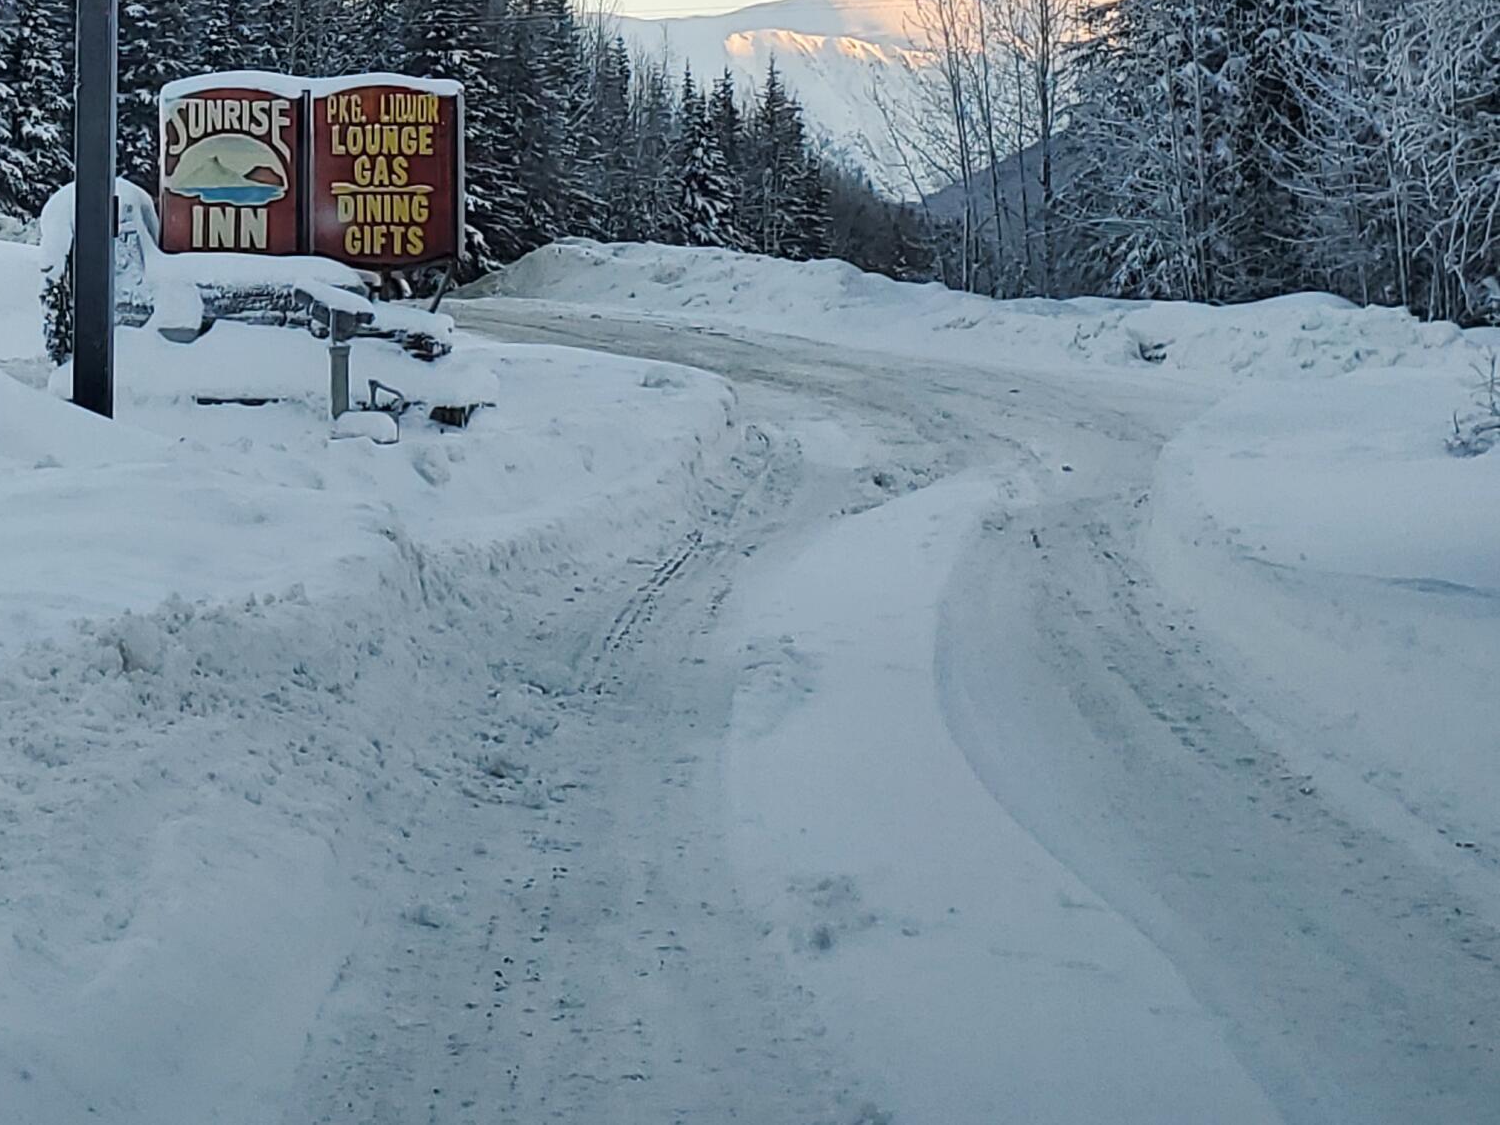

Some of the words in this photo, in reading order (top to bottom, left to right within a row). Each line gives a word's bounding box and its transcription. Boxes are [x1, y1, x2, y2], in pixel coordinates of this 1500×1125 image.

[327, 94, 367, 124] PKG.
[380, 93, 440, 124] LIQUOR
[167, 98, 291, 165] SUNRISE
[331, 124, 434, 155] LOUNGE
[354, 155, 409, 186] GAS
[337, 194, 429, 224] DINING
[192, 205, 268, 249] INN
[345, 225, 424, 255] GIFTS
